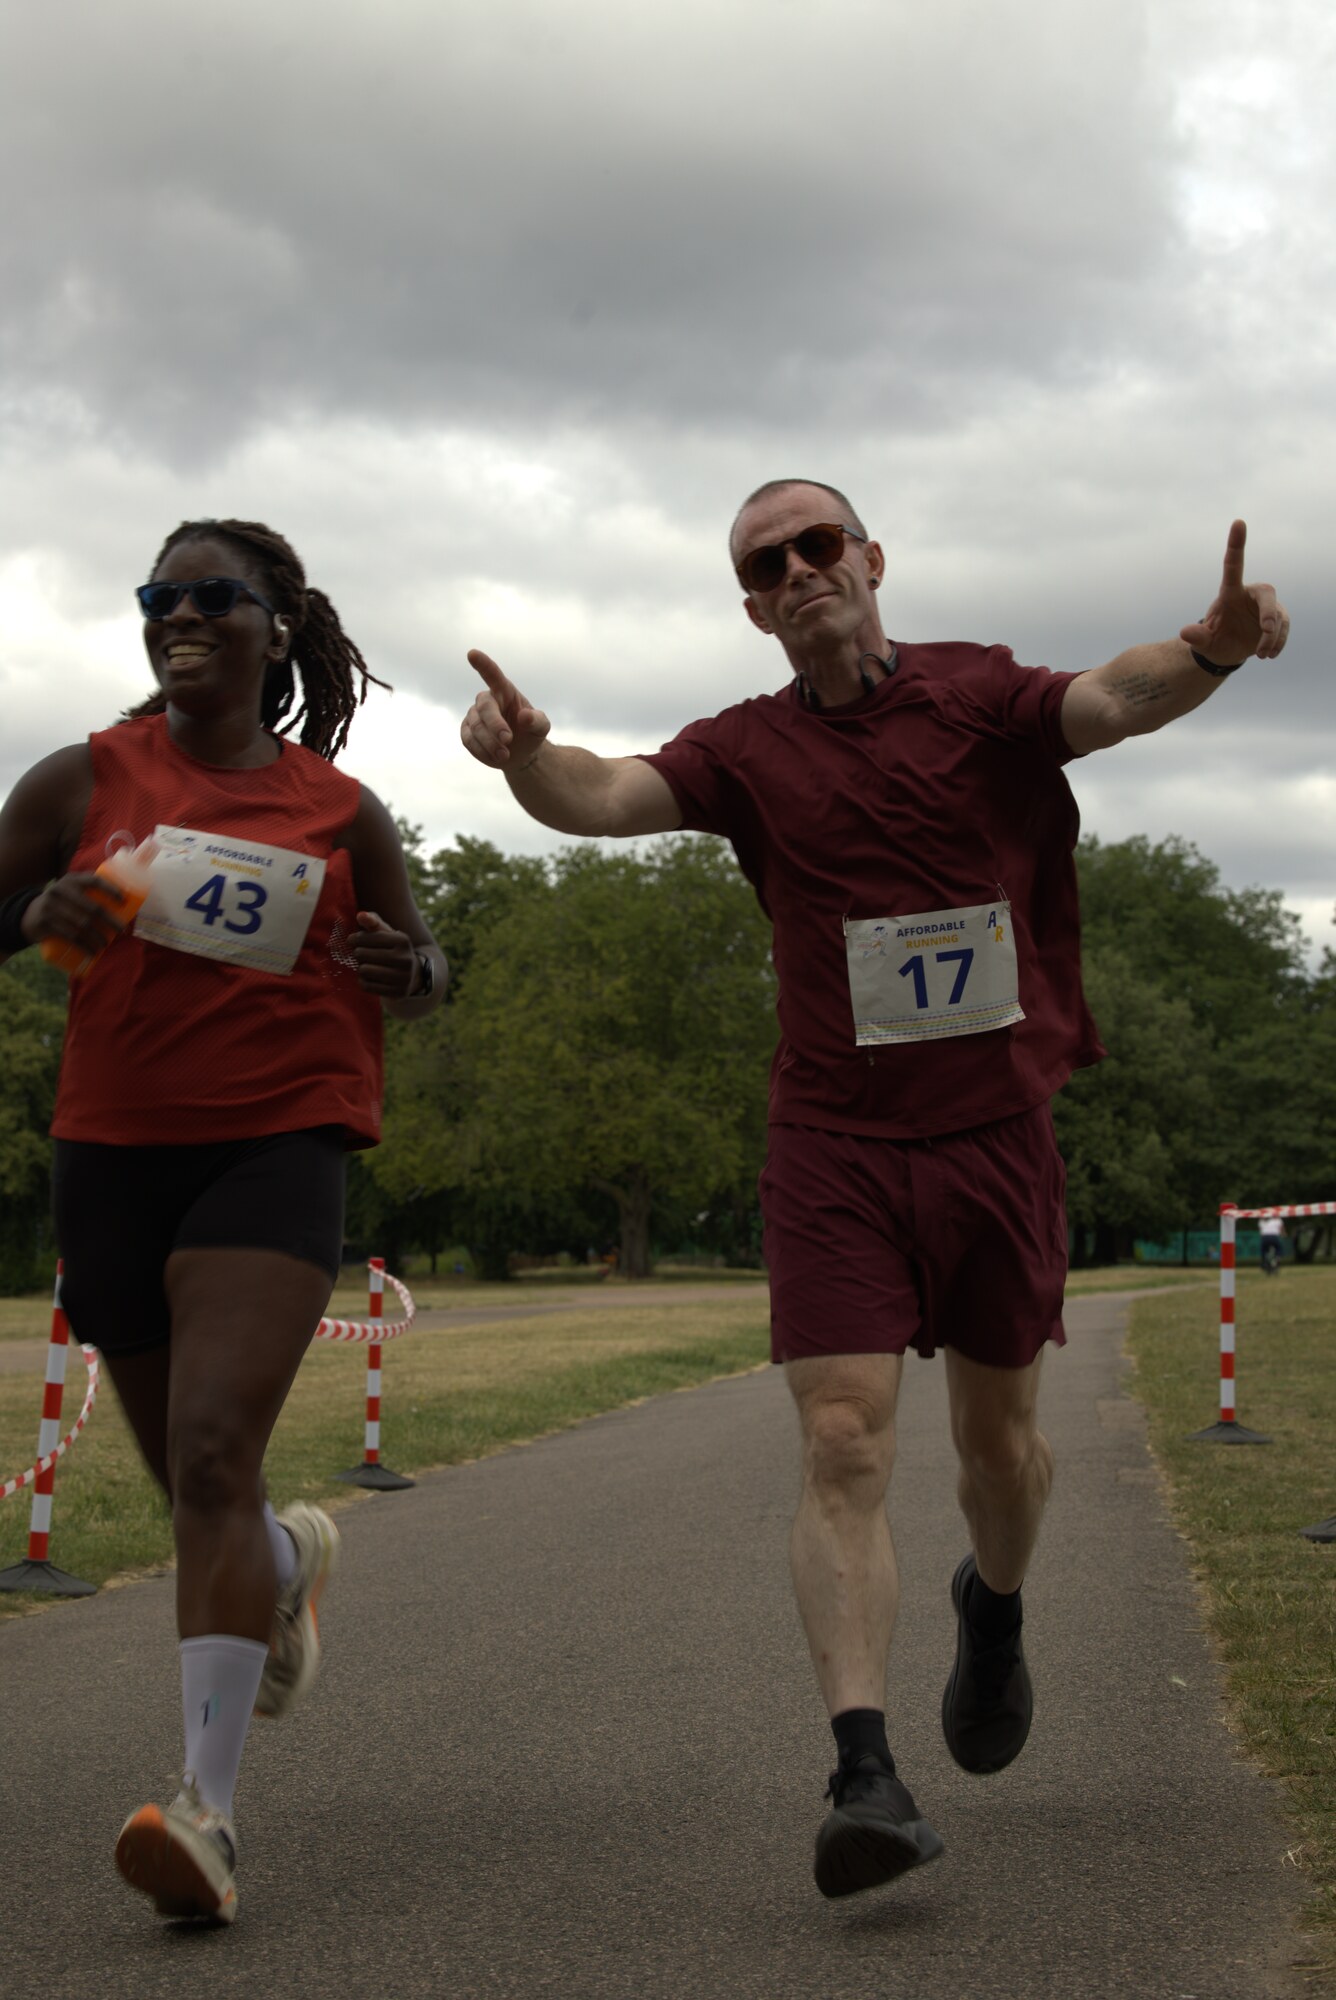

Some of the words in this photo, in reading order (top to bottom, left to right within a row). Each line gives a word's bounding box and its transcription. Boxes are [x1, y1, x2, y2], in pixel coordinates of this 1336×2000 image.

[205, 845, 273, 867] AFFORDABLE
[292, 864, 308, 879] A
[296, 879, 309, 895] R
[185, 874, 268, 934] 43
[898, 920, 965, 937] AFFORDABLE
[987, 911, 997, 929] A
[907, 934, 959, 949] RUNNING
[995, 926, 1003, 943] R
[898, 948, 974, 1009] 17
